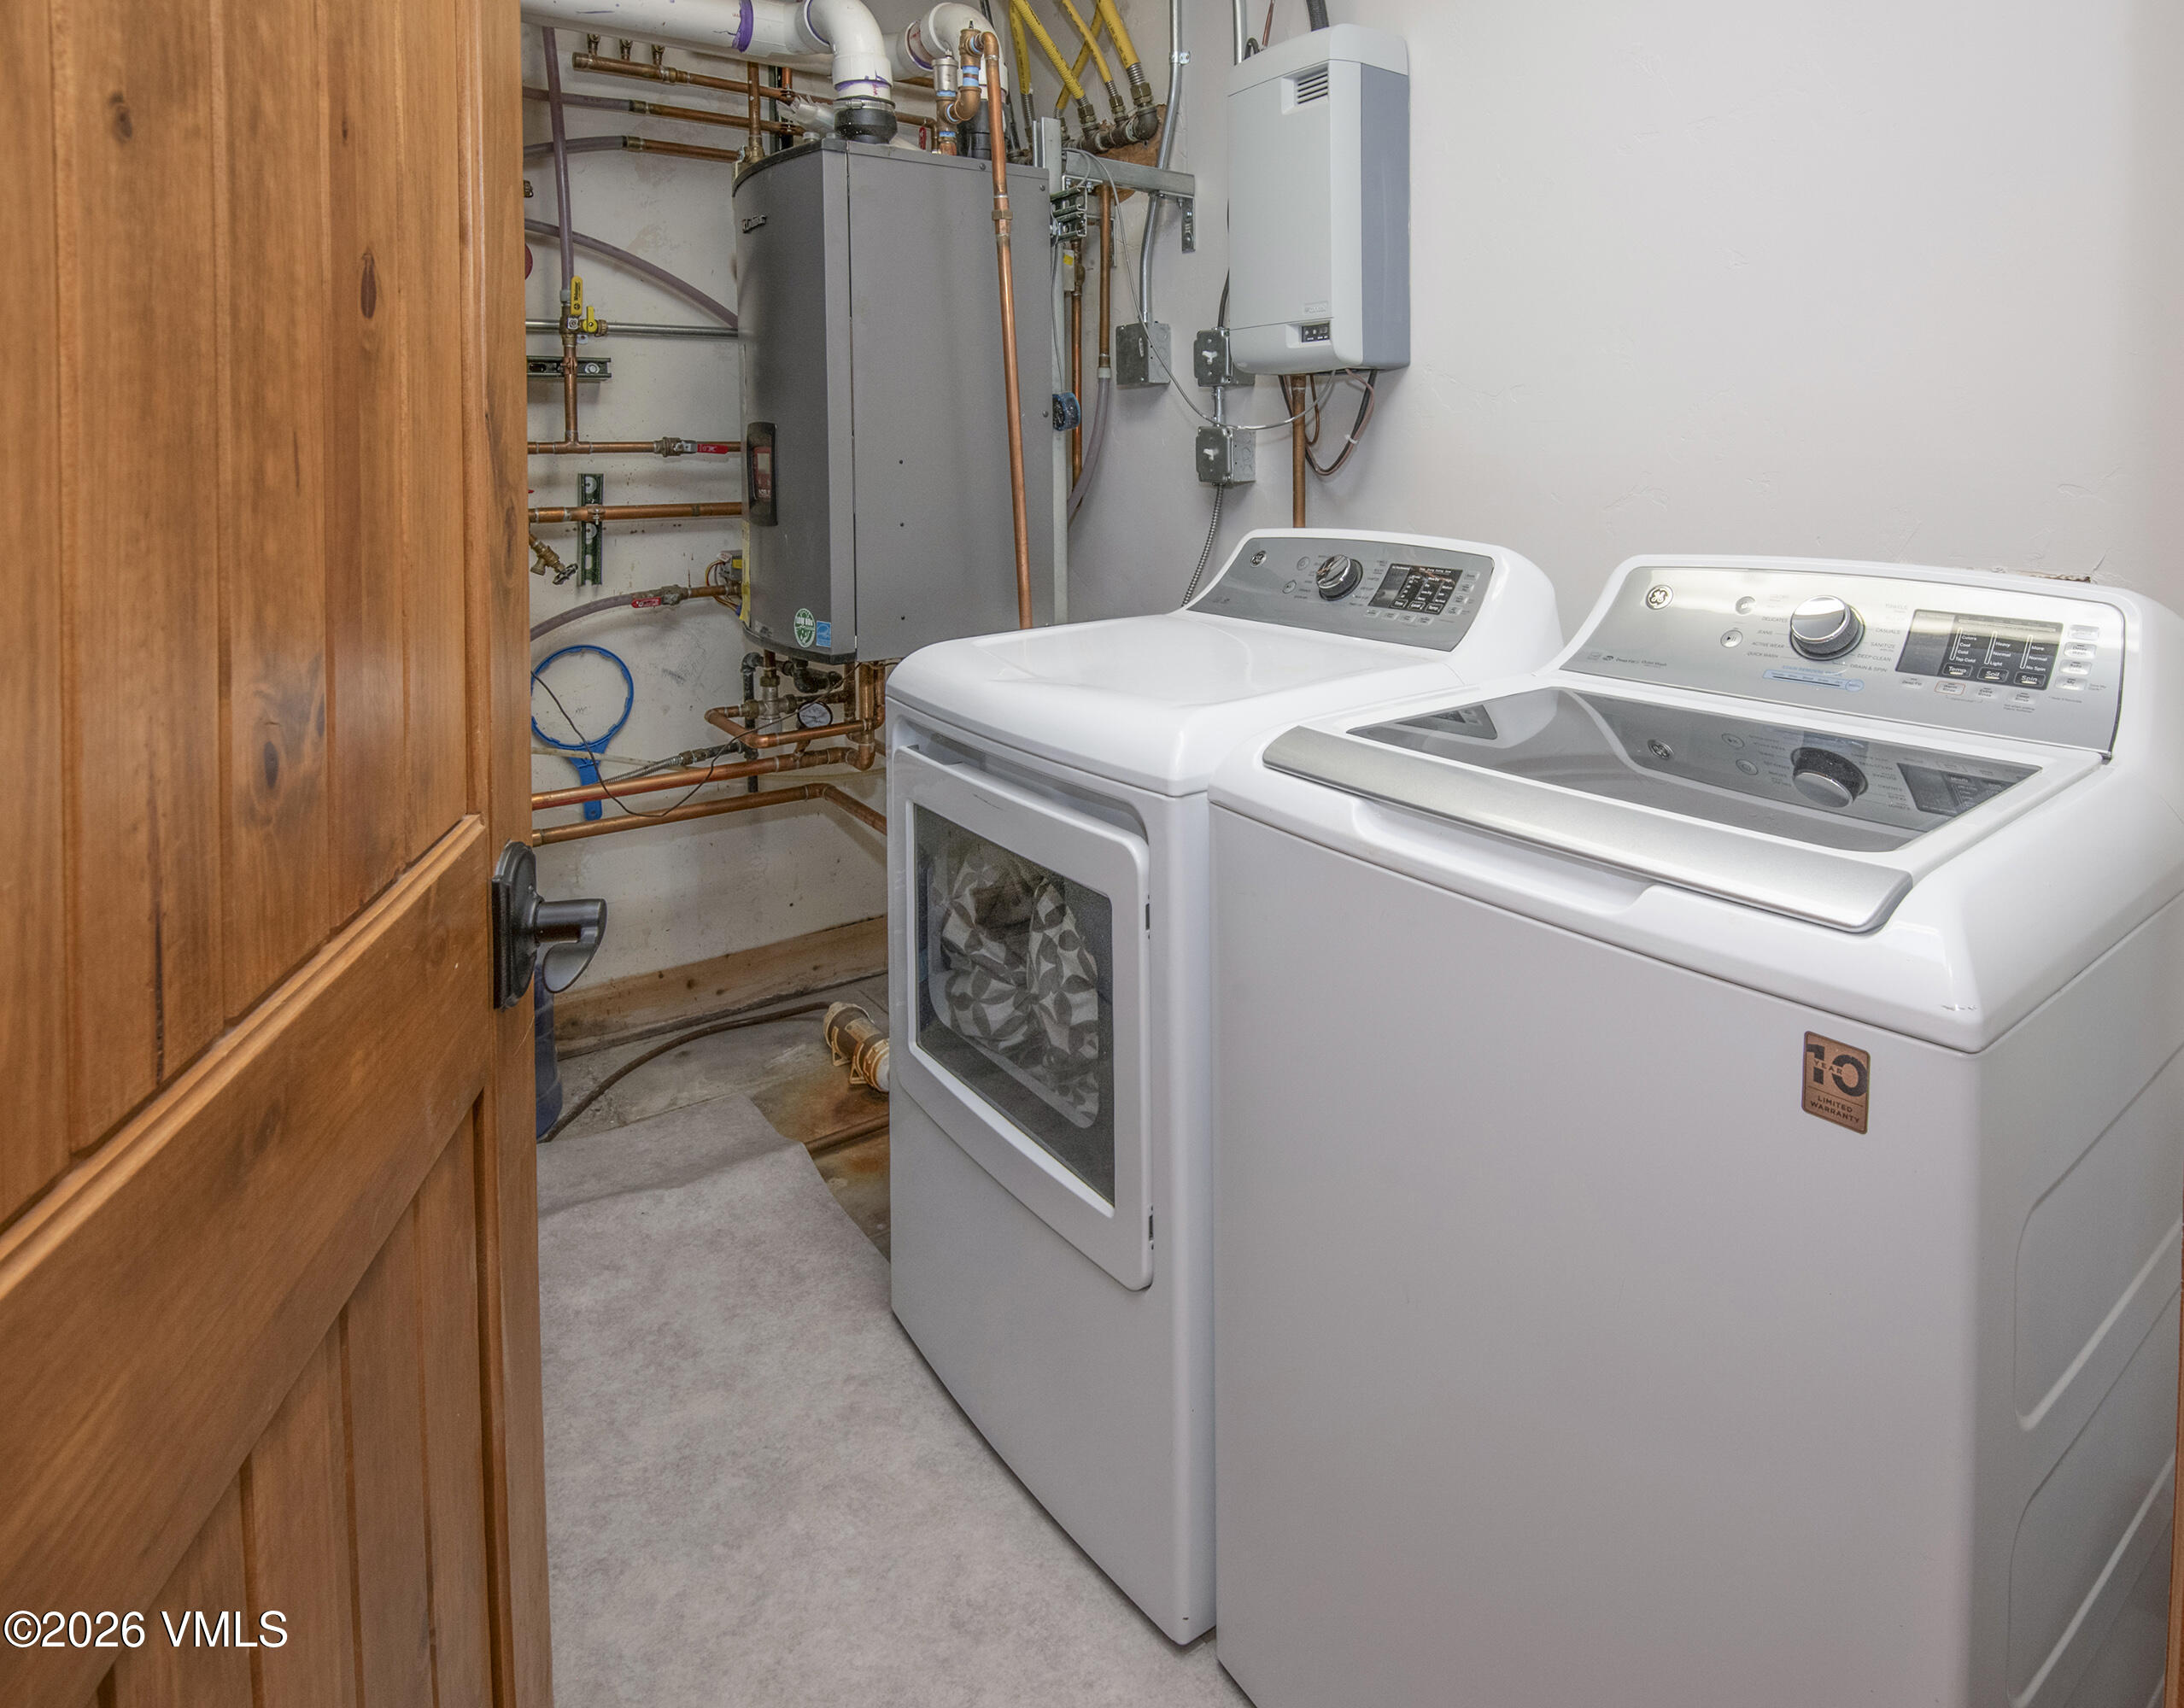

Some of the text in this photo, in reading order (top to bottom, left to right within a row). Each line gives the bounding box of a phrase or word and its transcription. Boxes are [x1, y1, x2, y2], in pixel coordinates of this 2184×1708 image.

[1948, 665, 1967, 674] Temp
[1806, 1044, 1867, 1097] 10
[1813, 1059, 1843, 1075] YEAR
[1810, 1100, 1860, 1124] WARRANTY
[1818, 1095, 1853, 1113] LIMITED
